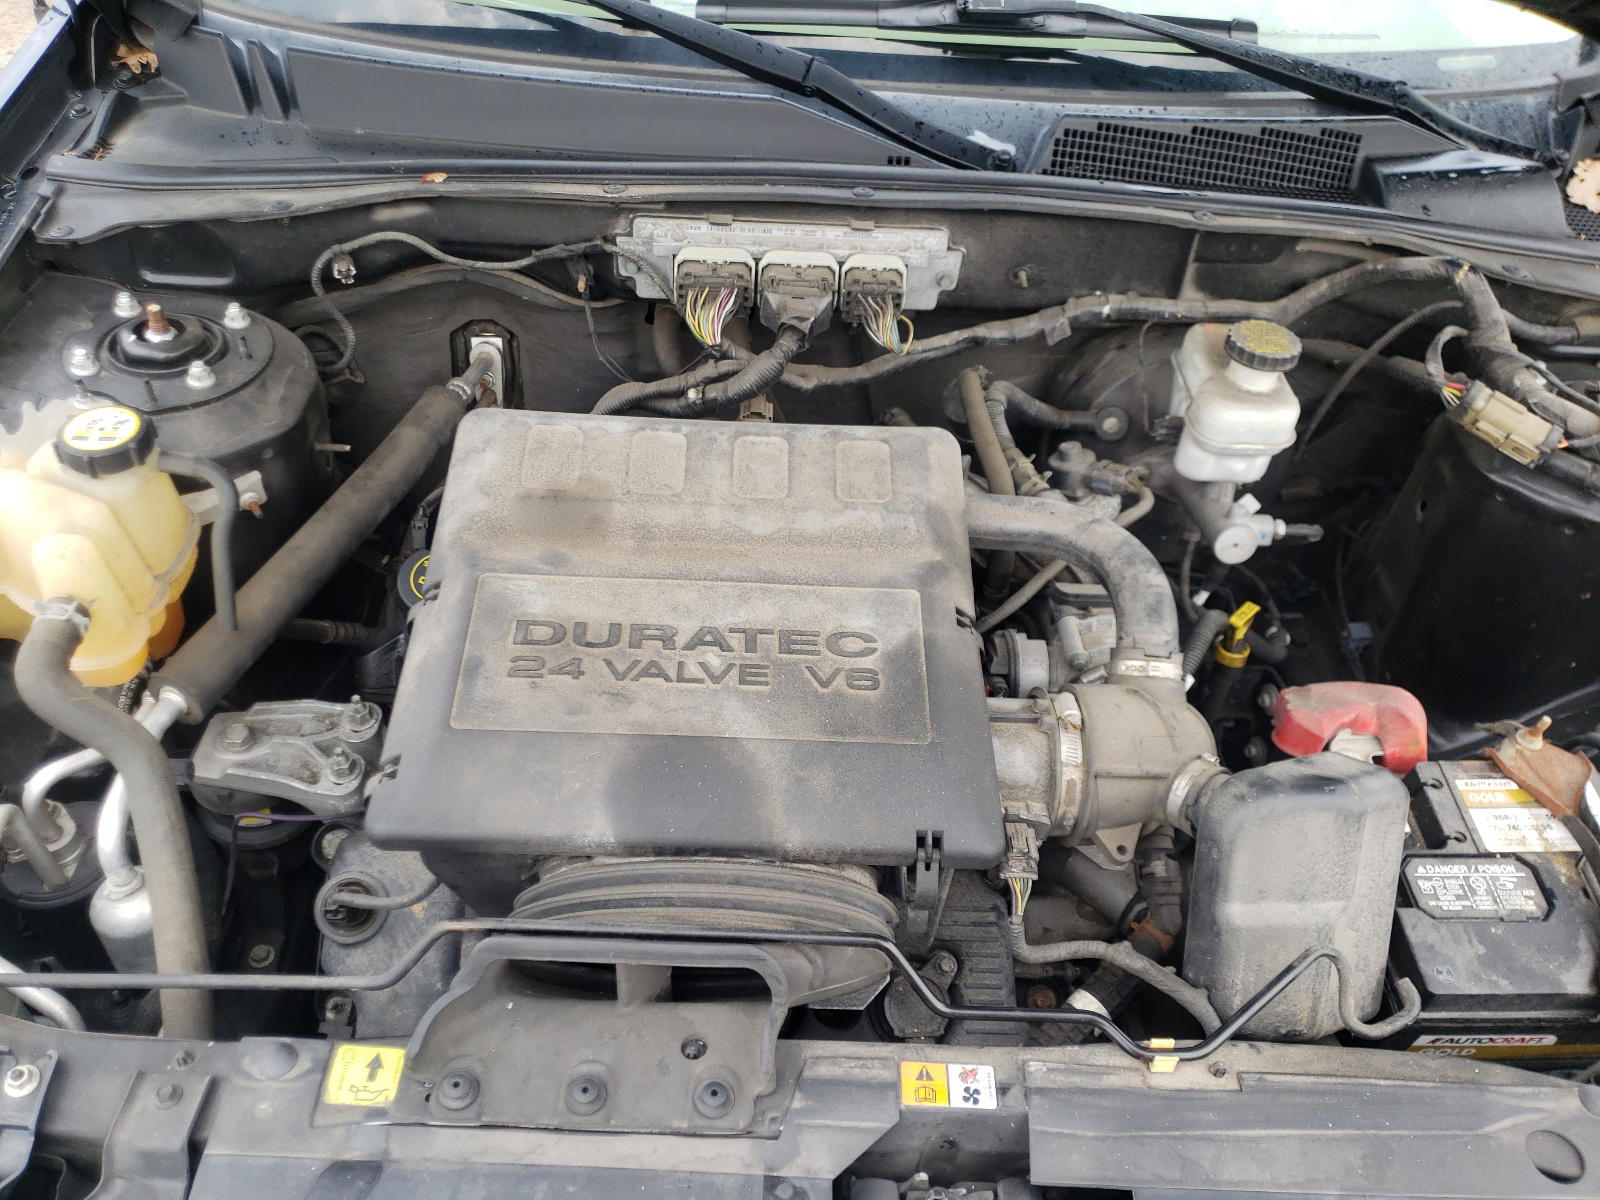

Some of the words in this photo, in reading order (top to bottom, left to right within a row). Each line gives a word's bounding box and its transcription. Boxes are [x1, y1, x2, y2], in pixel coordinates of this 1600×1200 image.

[513, 619, 880, 658] DURATEC
[507, 654, 585, 681] 24
[603, 657, 770, 687] VALVE
[805, 664, 881, 692] V6
[1426, 863, 1469, 873] DANGER
[1478, 863, 1517, 874] POISON
[1442, 1037, 1548, 1045] AUTOCRAFT
